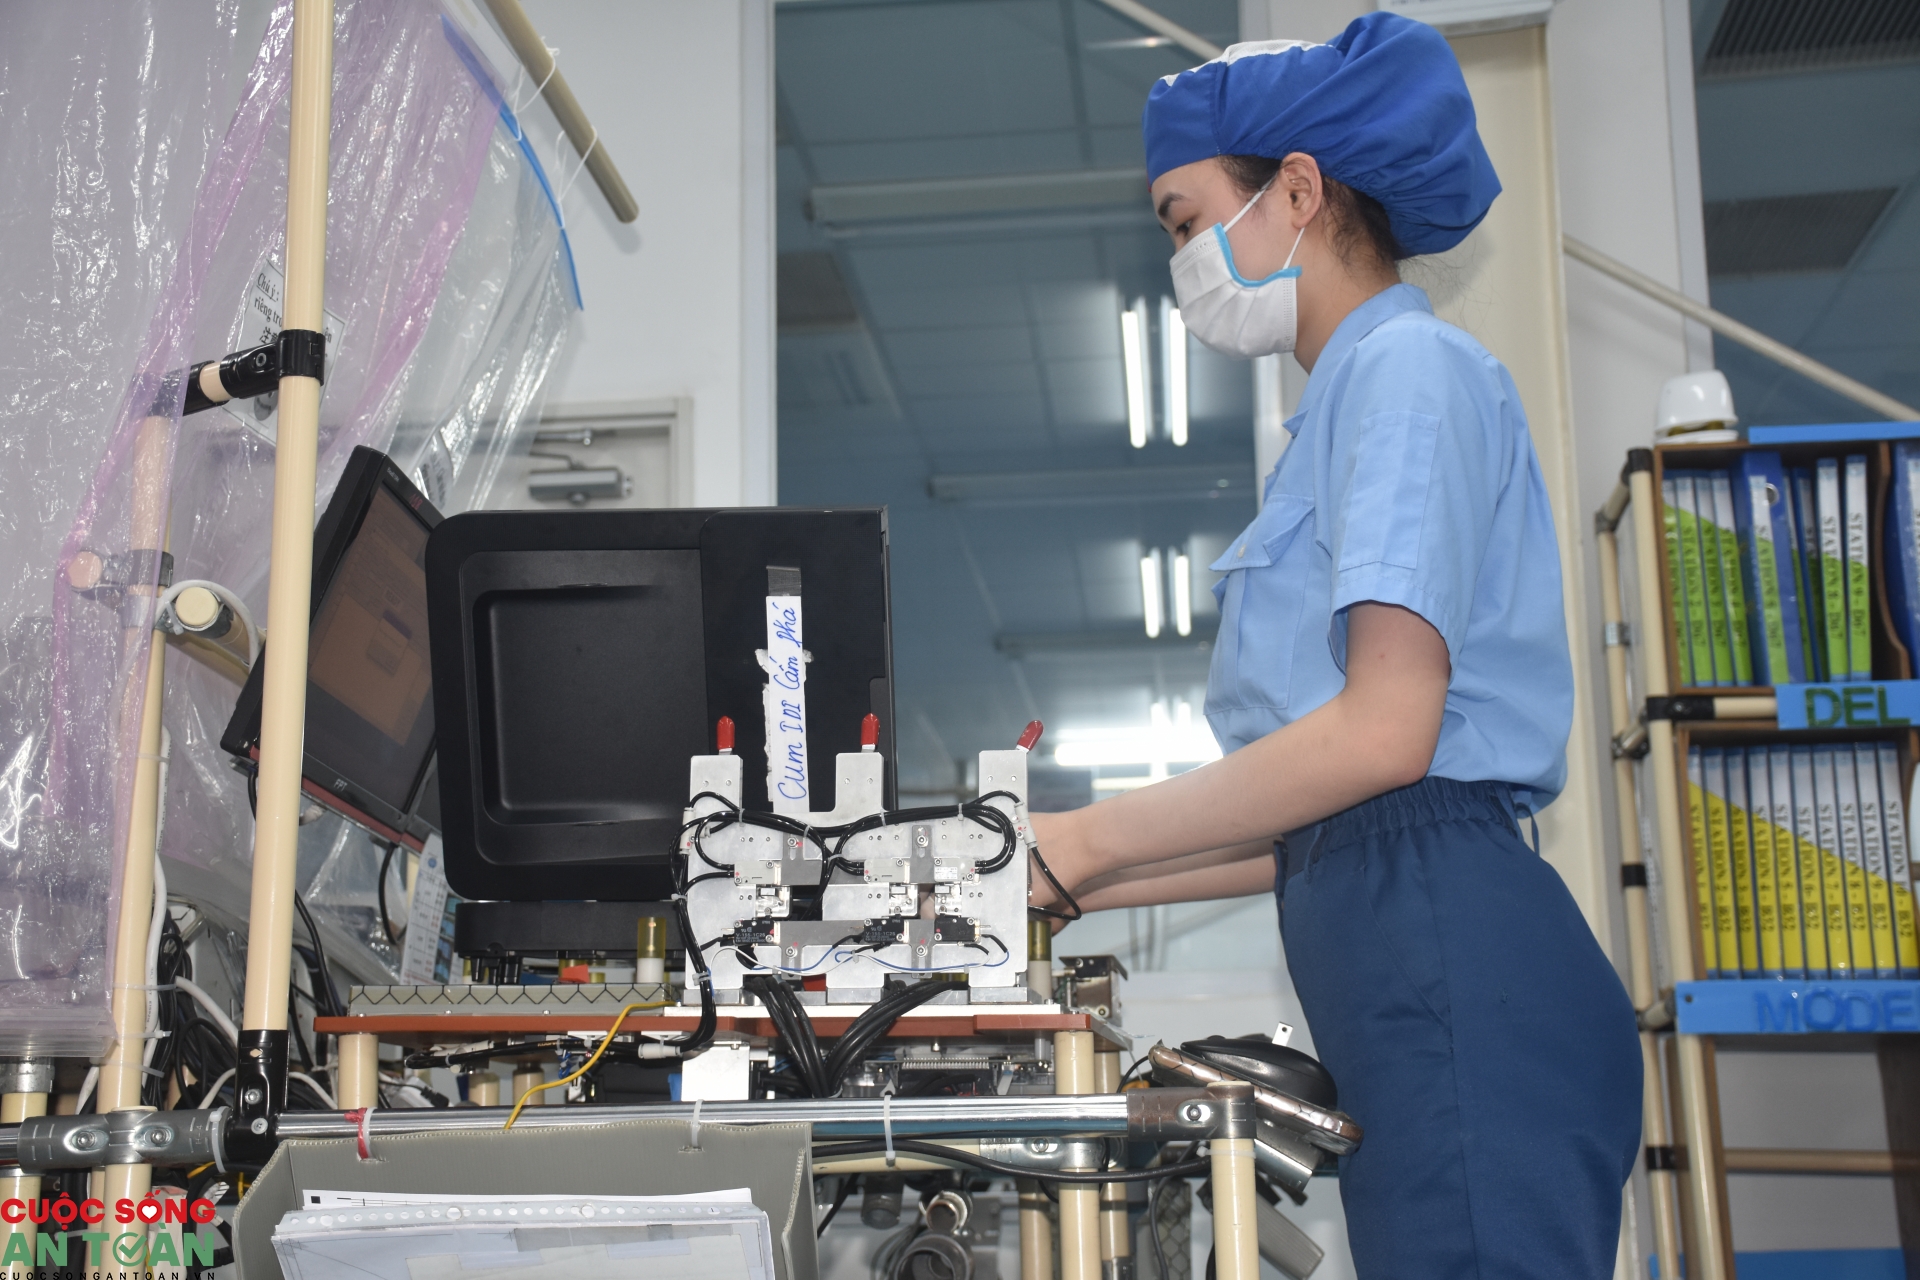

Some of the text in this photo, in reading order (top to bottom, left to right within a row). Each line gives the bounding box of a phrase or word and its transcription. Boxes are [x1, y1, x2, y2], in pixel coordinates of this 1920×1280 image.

[258, 273, 270, 293] Chú
[254, 297, 272, 322] riêng
[1821, 515, 1842, 587] STATION
[1847, 511, 1870, 584] STATION
[1827, 590, 1840, 600] 8
[1852, 586, 1865, 597] 9
[1804, 686, 1910, 728] DEL
[333, 778, 348, 792] FPT
[777, 742, 807, 799] Cum
[1708, 806, 1729, 880] STATION
[1730, 806, 1751, 880] STATION
[1752, 805, 1772, 879] STATION
[1772, 803, 1794, 878] STATION
[1795, 805, 1817, 881] STATION
[1817, 803, 1839, 878] STATION
[1839, 801, 1861, 877] STATION
[1861, 801, 1883, 878] STATION
[1886, 799, 1907, 875] STATION
[1715, 883, 1729, 893] 2
[1738, 883, 1752, 893] 3
[1759, 881, 1773, 893] 4
[1780, 880, 1795, 892] 5
[1825, 881, 1841, 891] 7
[1848, 879, 1863, 891] 8
[1870, 879, 1885, 891] 9
